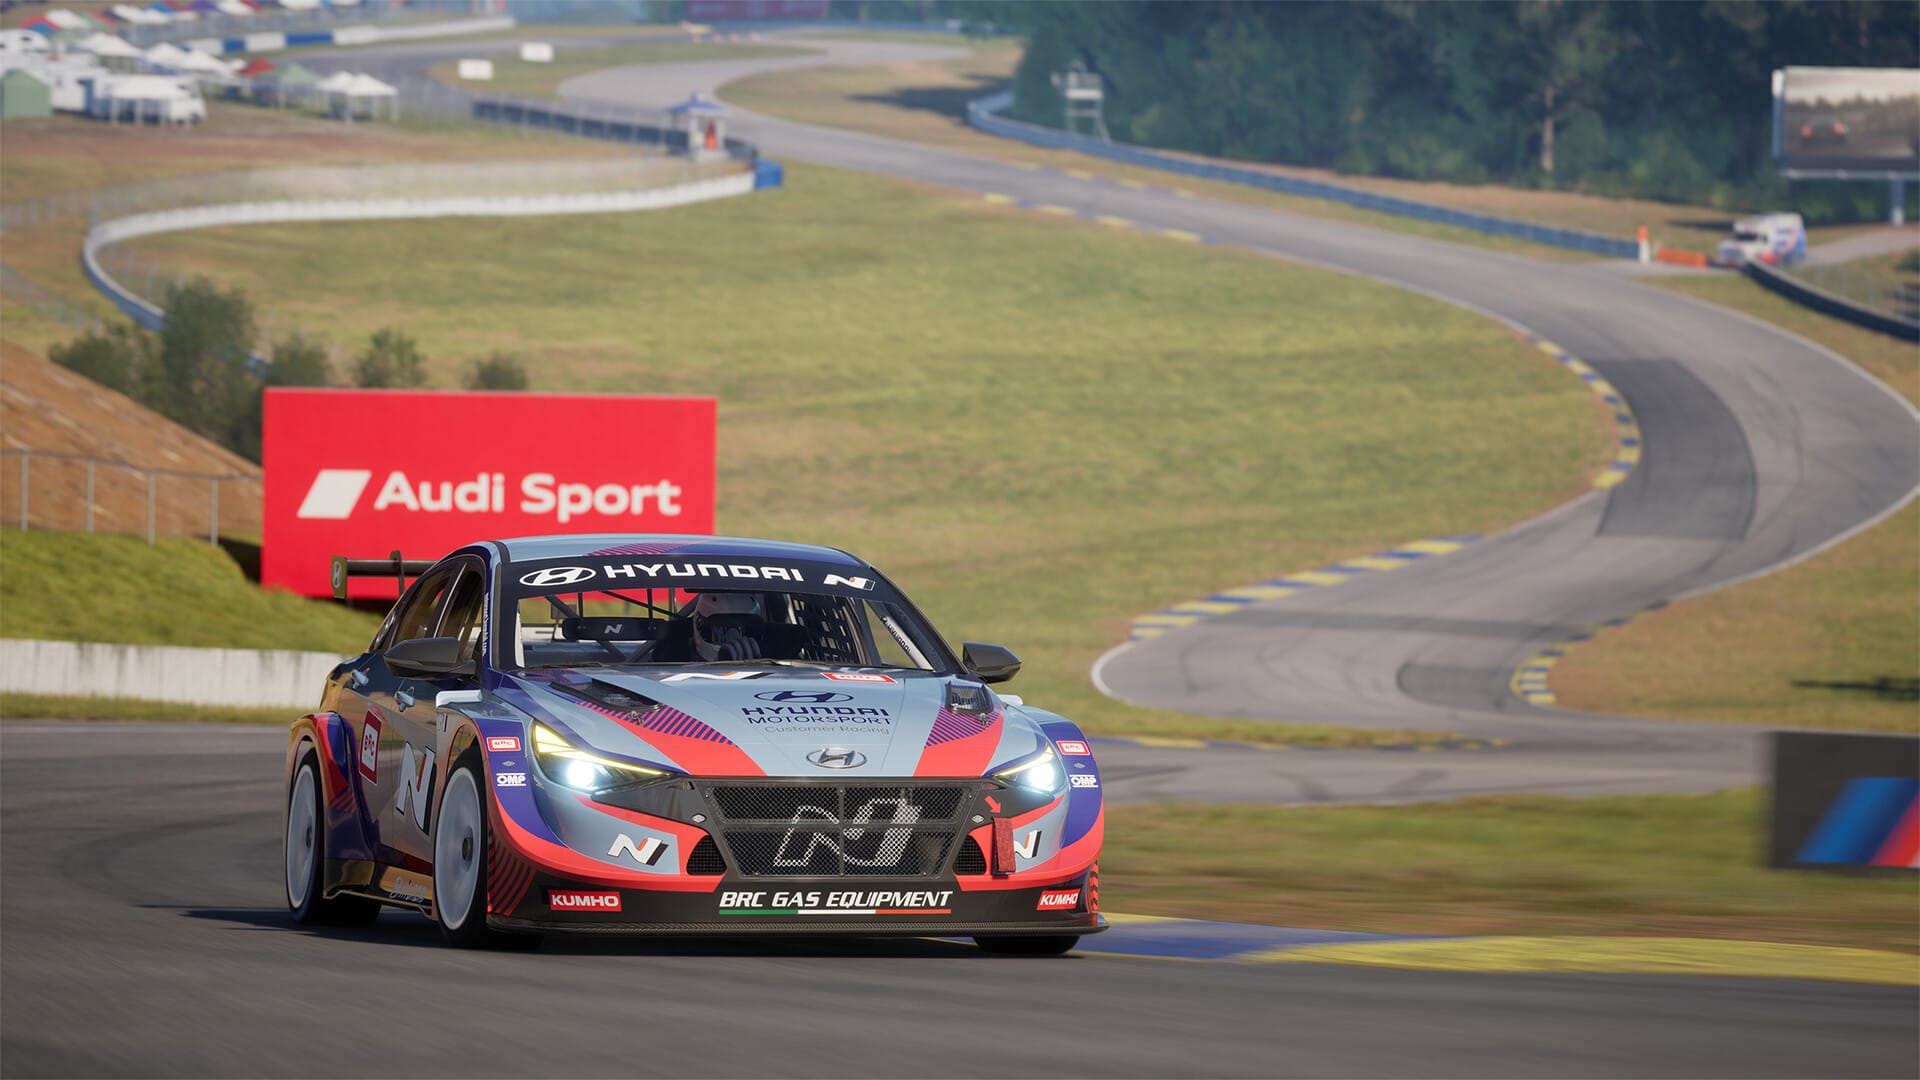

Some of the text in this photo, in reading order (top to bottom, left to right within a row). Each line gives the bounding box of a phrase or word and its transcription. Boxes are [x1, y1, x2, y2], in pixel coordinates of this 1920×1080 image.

[374, 470, 682, 523] Audi Sport
[603, 563, 804, 582] HYUNDAI
[741, 706, 890, 717] HYUNDAI
[747, 716, 891, 725] MOTORSPORT
[764, 725, 890, 736] Customer Racing
[496, 775, 526, 785] OMP
[1070, 776, 1098, 786] OMP
[551, 894, 619, 907] KUMHO
[719, 891, 953, 909] BRC GAS EQUIPMENT
[1040, 892, 1079, 907] KUMHO
